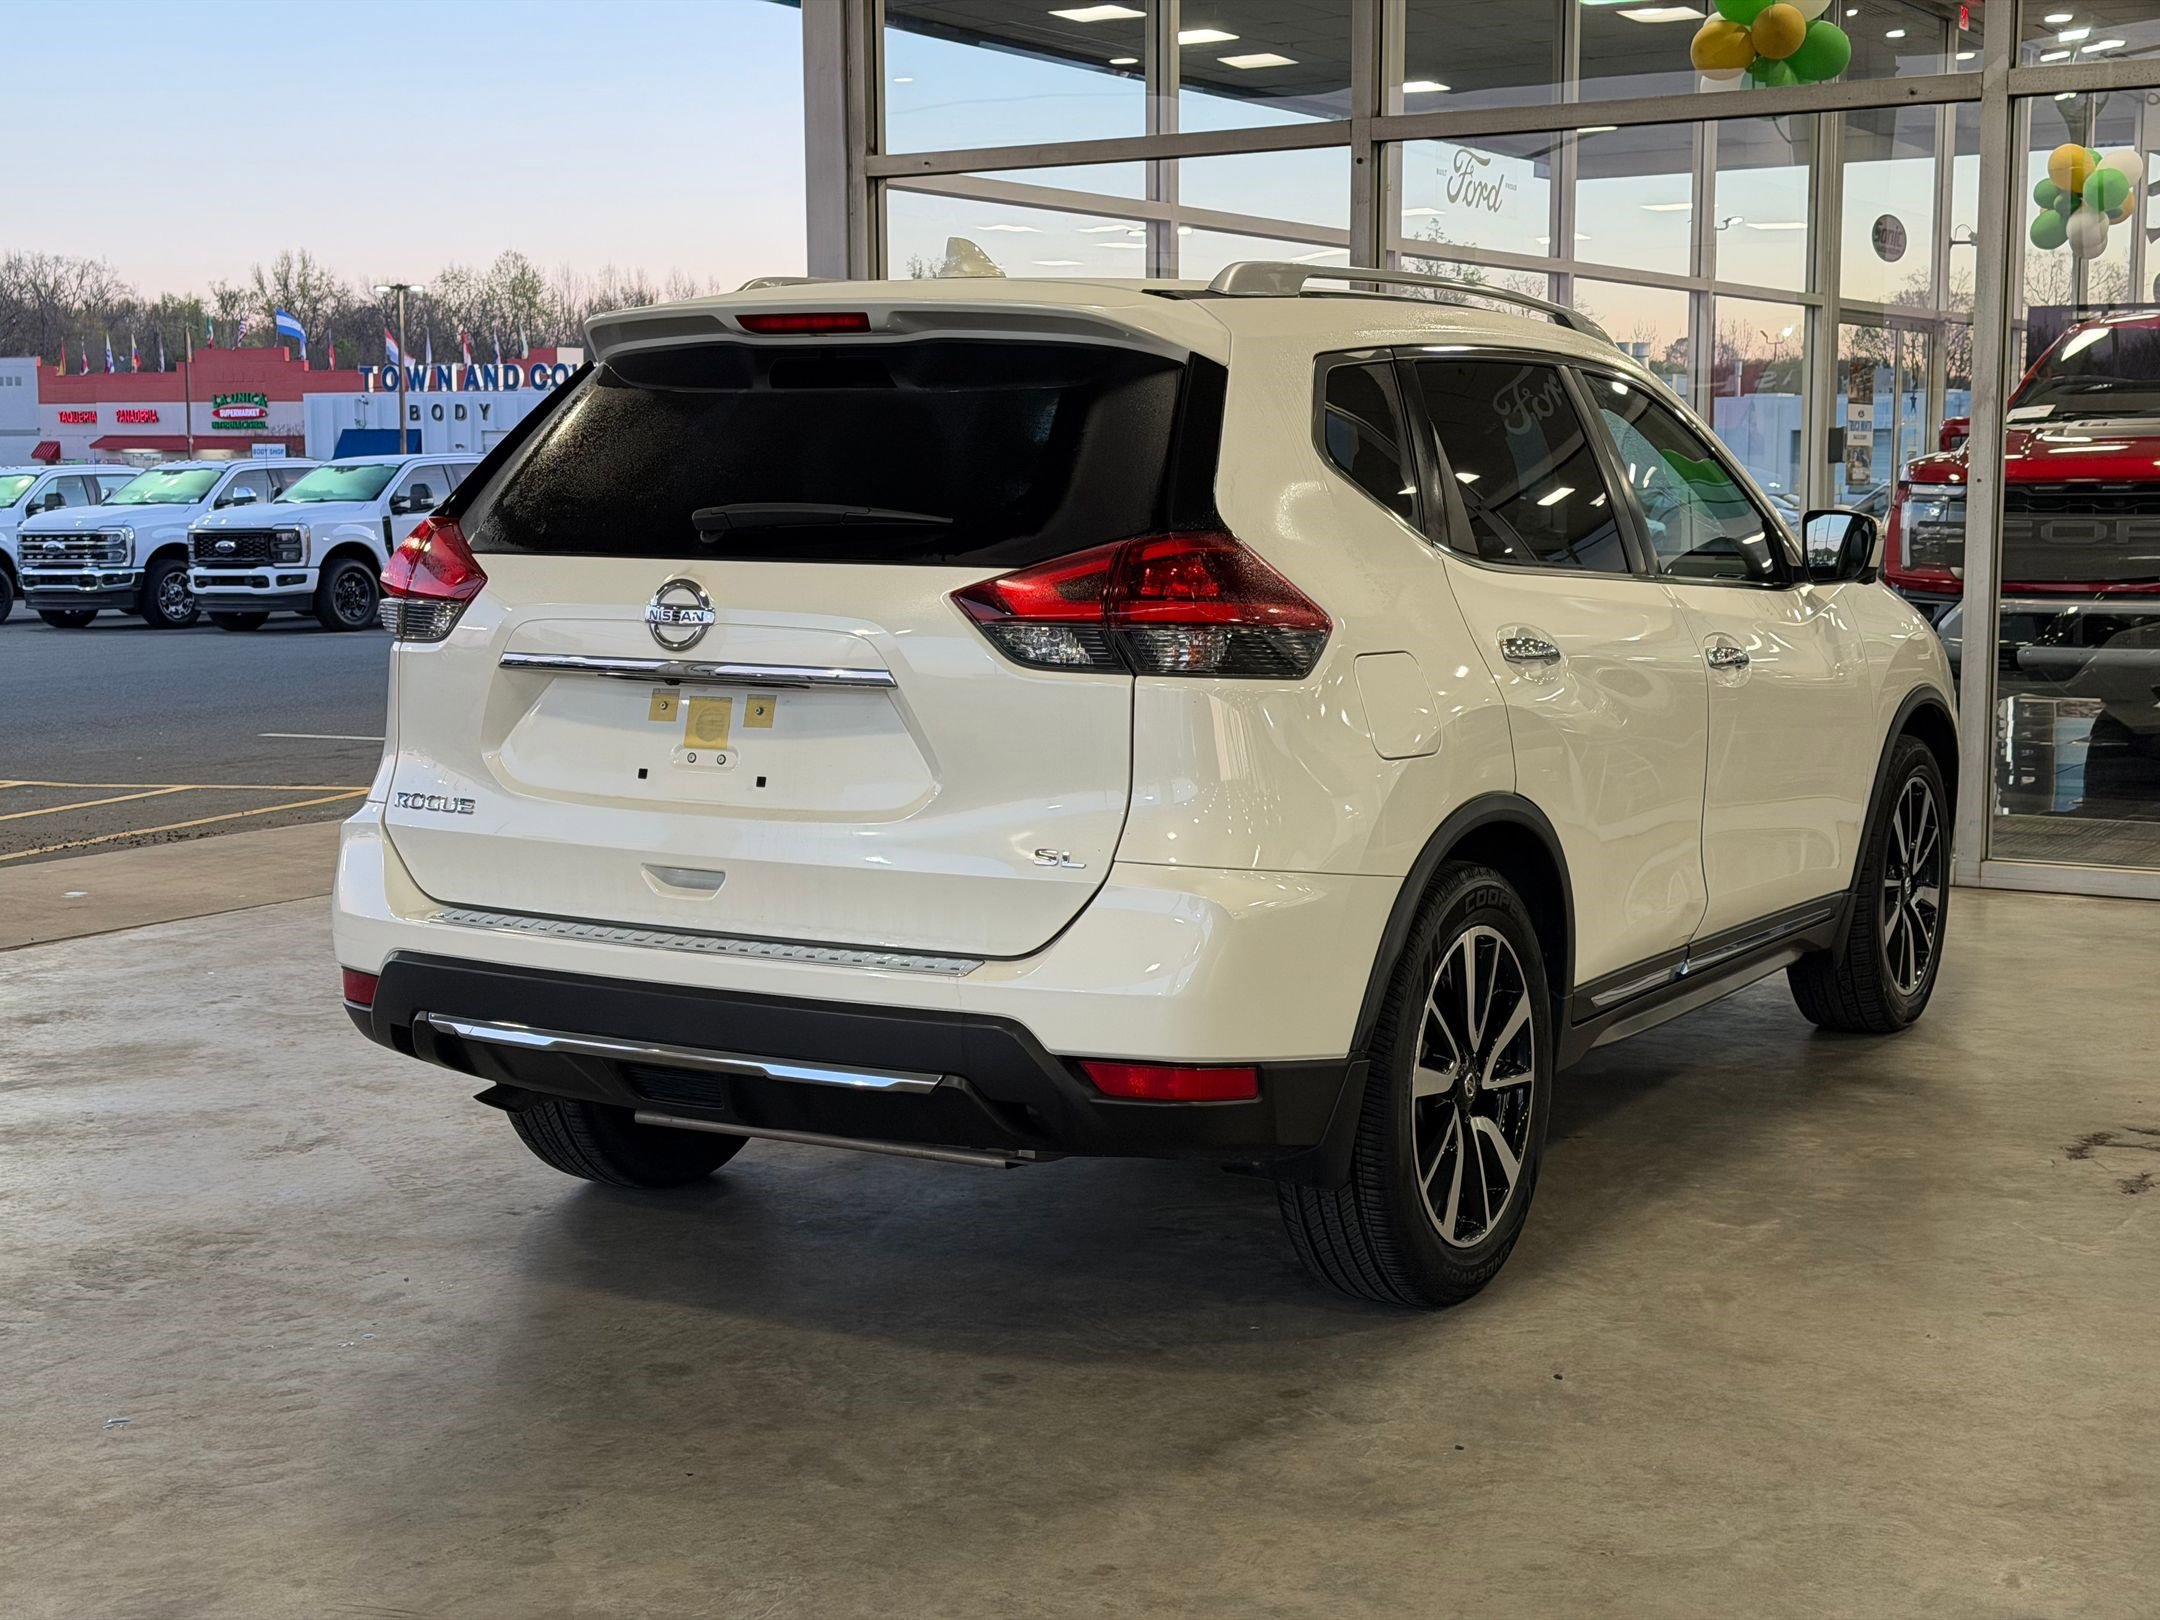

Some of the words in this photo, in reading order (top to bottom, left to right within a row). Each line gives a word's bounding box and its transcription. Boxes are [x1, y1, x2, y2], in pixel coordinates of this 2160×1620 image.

[1446, 148, 1504, 213] Ford
[359, 363, 458, 392] TOWN
[464, 363, 524, 392] AND
[58, 410, 97, 424] TAQUERIA
[115, 409, 159, 423] PANADERIA
[219, 408, 260, 418] SUPERMARKET
[409, 403, 491, 421] BODY
[648, 609, 704, 622] NISSAN
[394, 792, 476, 815] ROGUE
[1033, 848, 1087, 870] SL
